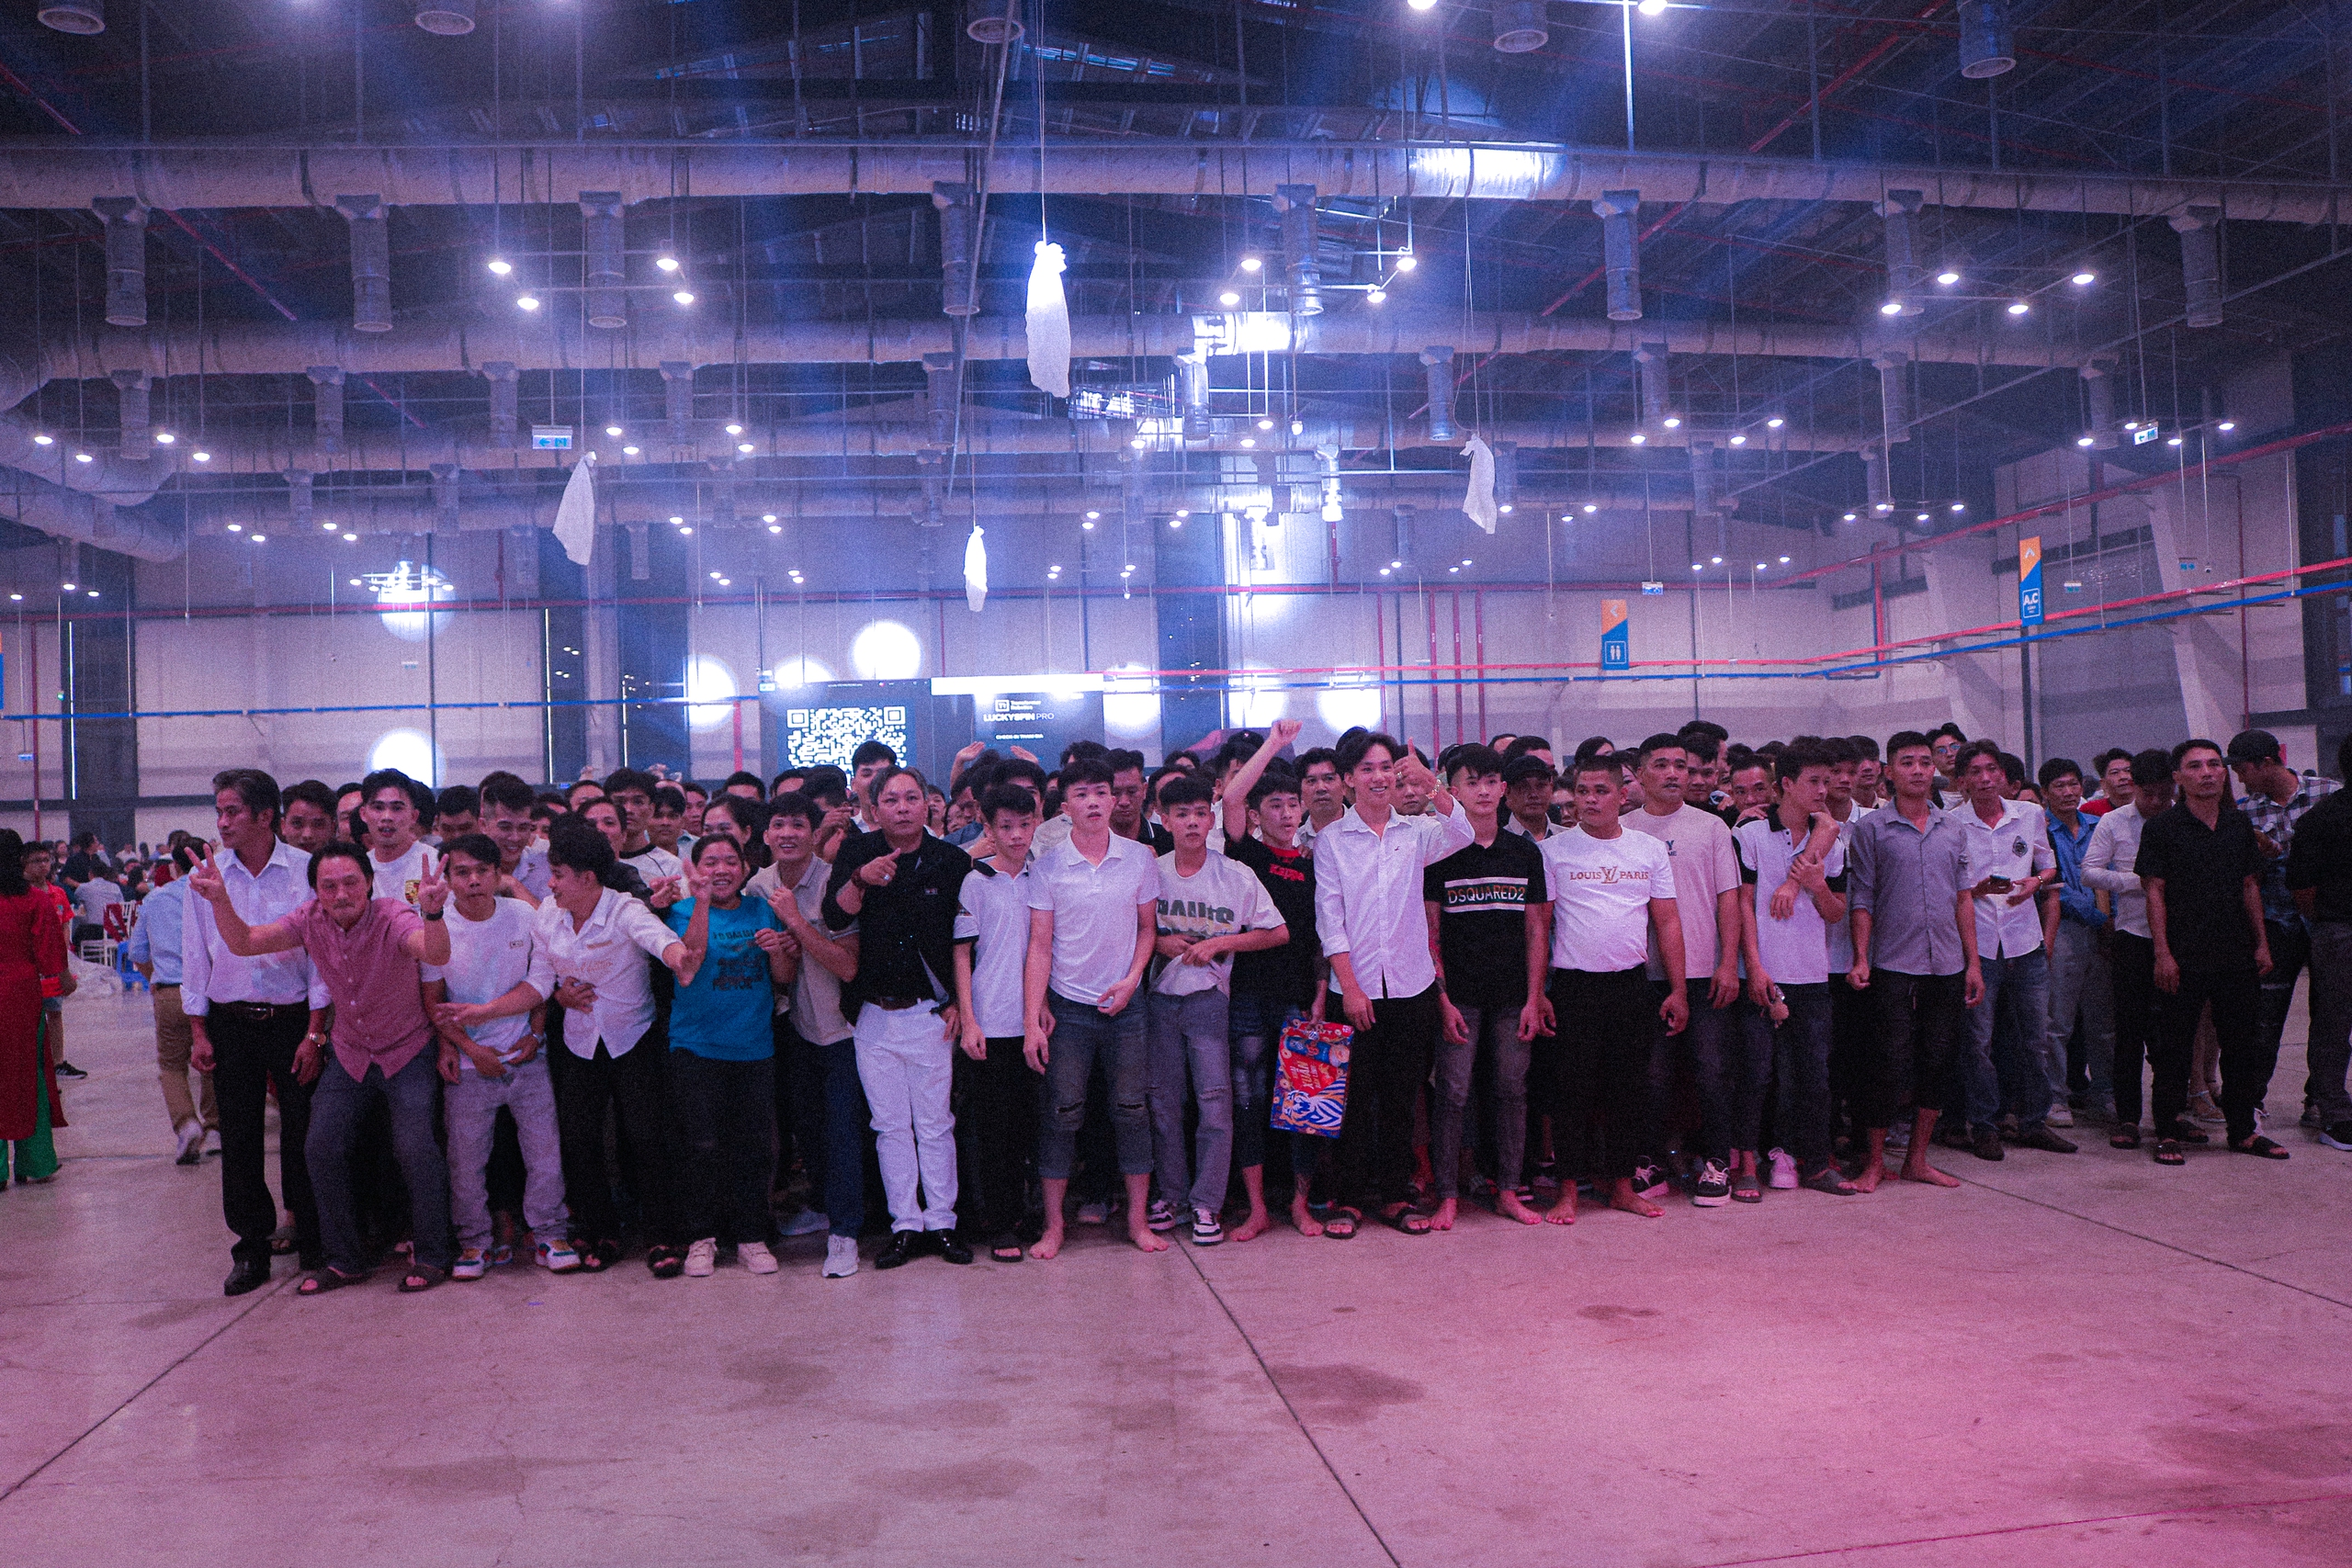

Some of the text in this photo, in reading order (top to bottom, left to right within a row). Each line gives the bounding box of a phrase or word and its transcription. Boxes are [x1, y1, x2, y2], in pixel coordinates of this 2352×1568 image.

[983, 713, 1035, 722] LUCKYSPIN
[1570, 871, 1601, 880] LOUIS
[1620, 871, 1649, 880] PARIS
[1447, 885, 1525, 904] DSQUARED2
